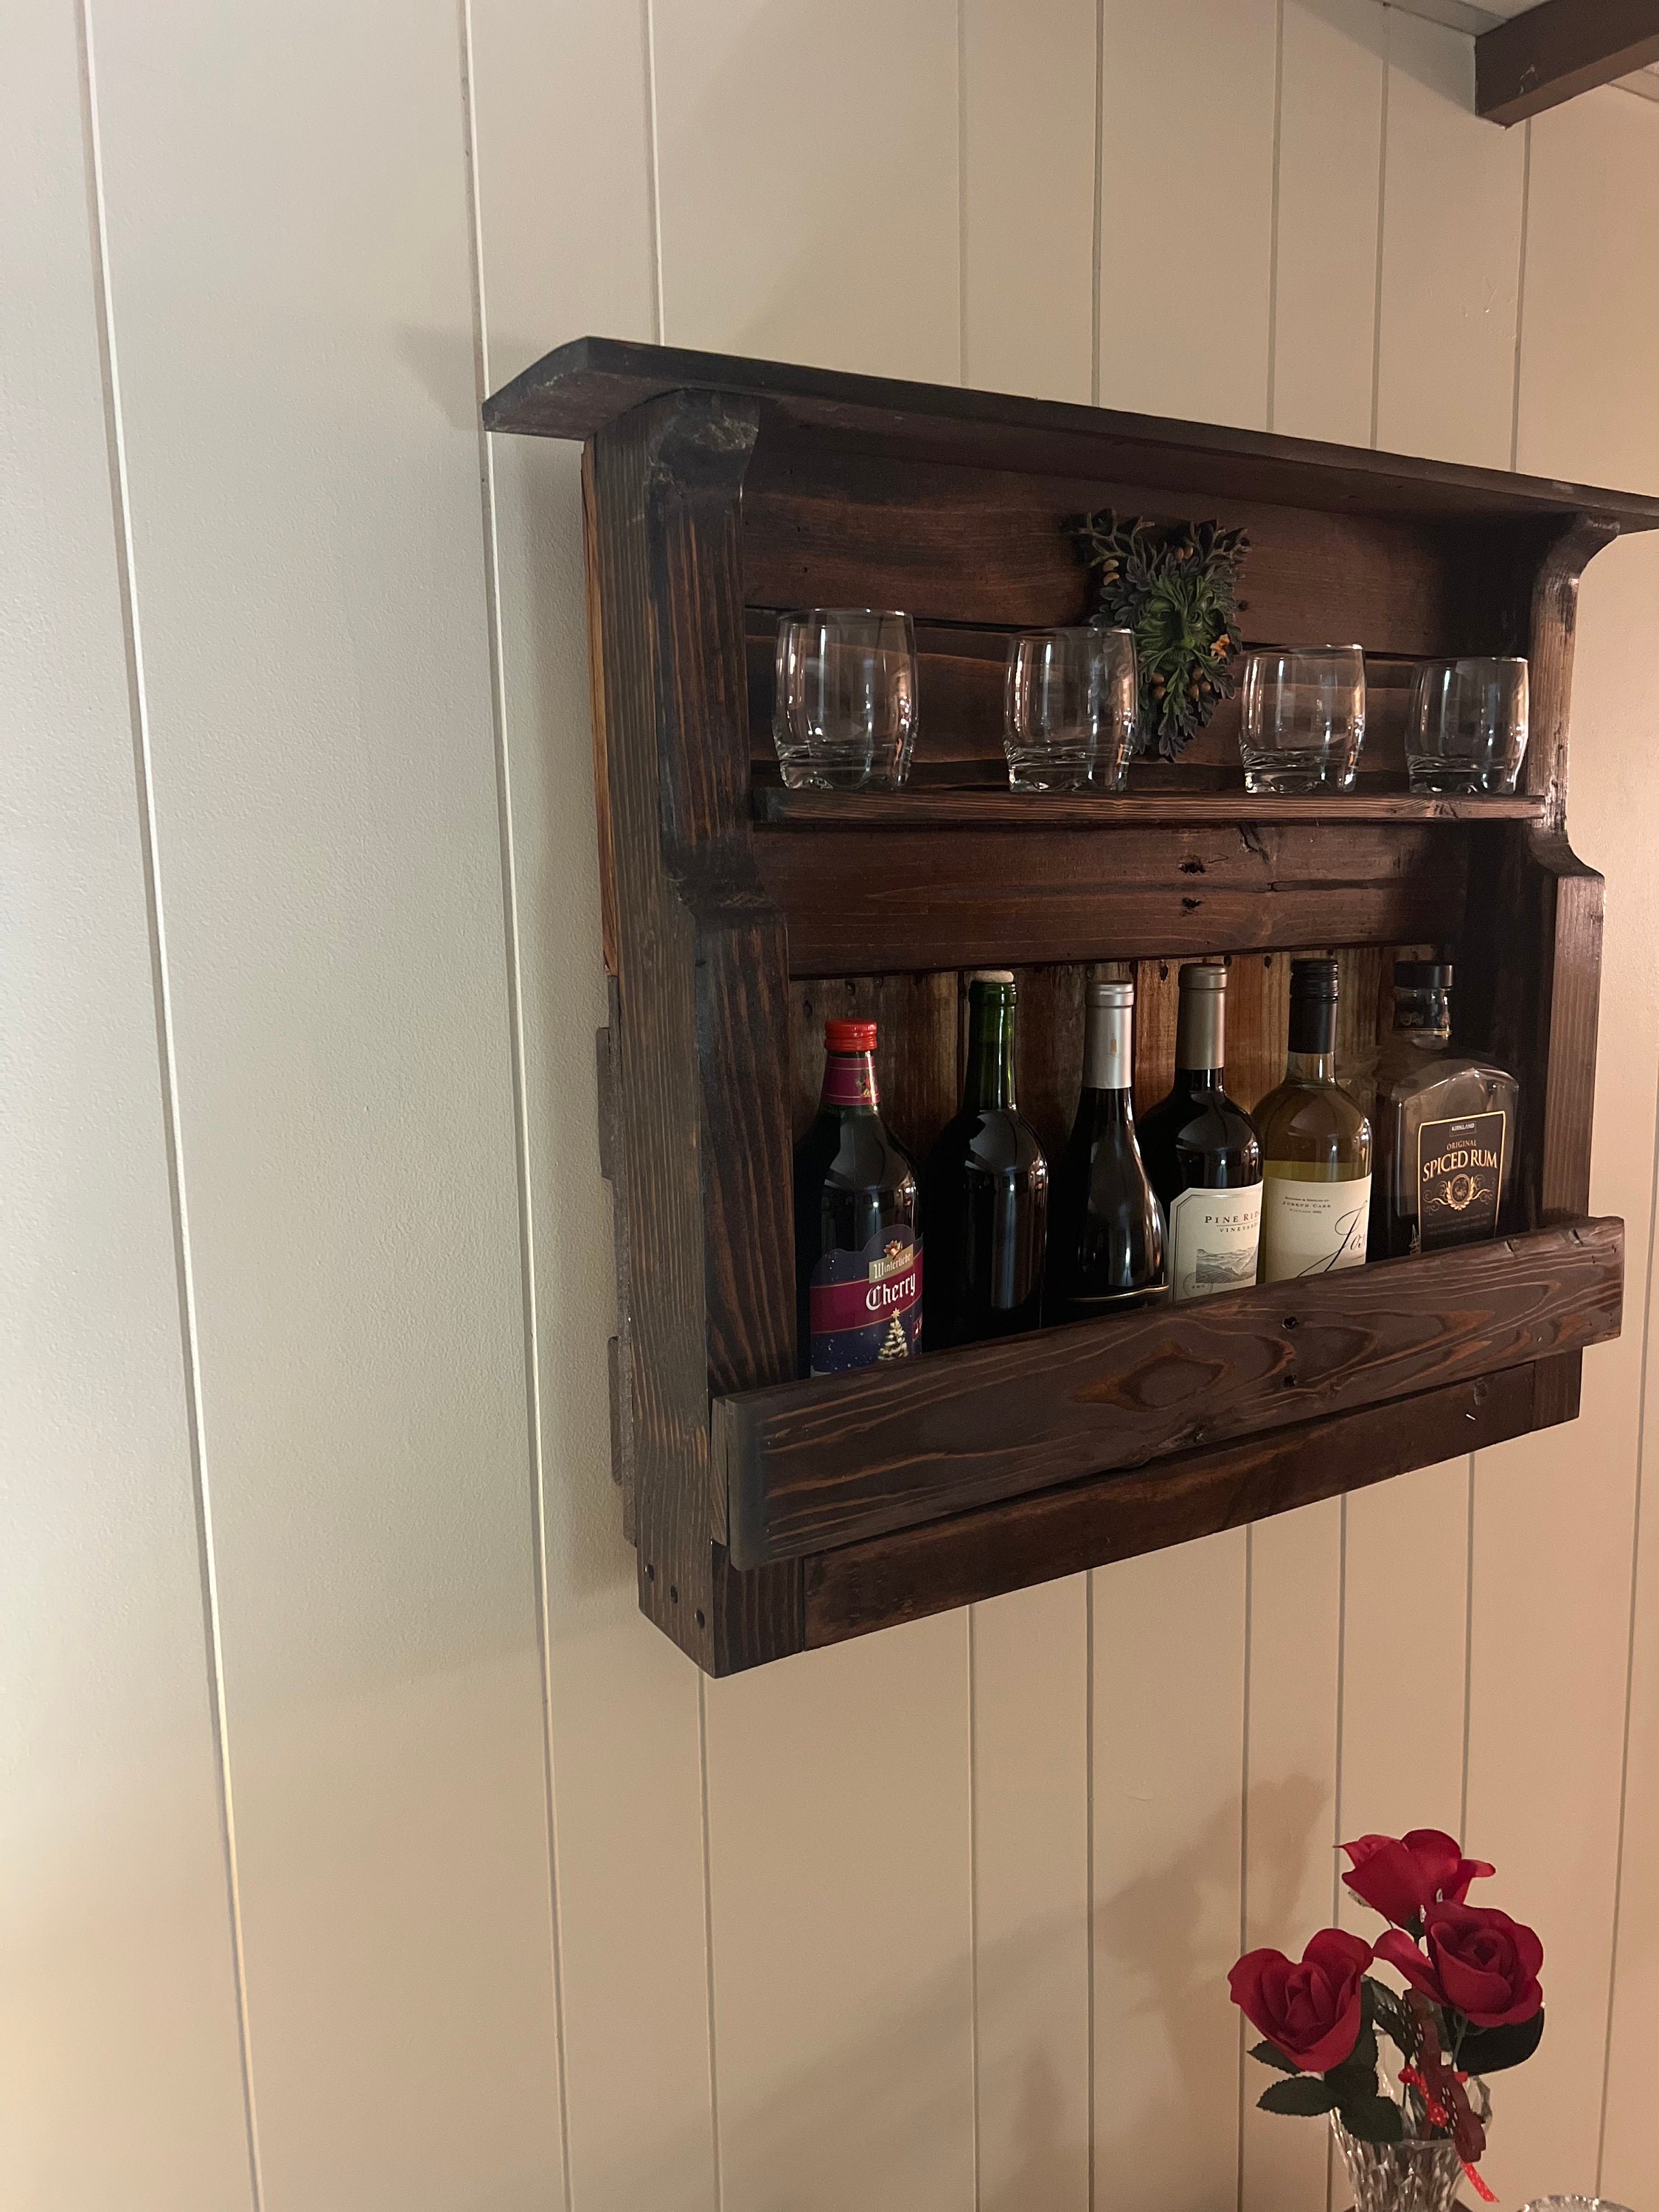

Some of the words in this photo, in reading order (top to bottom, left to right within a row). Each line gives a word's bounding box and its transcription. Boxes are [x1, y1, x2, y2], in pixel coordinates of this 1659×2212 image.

[1451, 1123, 1475, 1131] KIRKLAND
[1447, 1139, 1477, 1150] ORIGINAL
[1422, 1150, 1469, 1182] SPICED
[1470, 1149, 1498, 1169] RUM
[1205, 1215, 1239, 1223] PINE
[1243, 1211, 1259, 1221] RID
[1220, 1222, 1259, 1232] VINEYARD
[866, 1273, 916, 1311] Cherry
